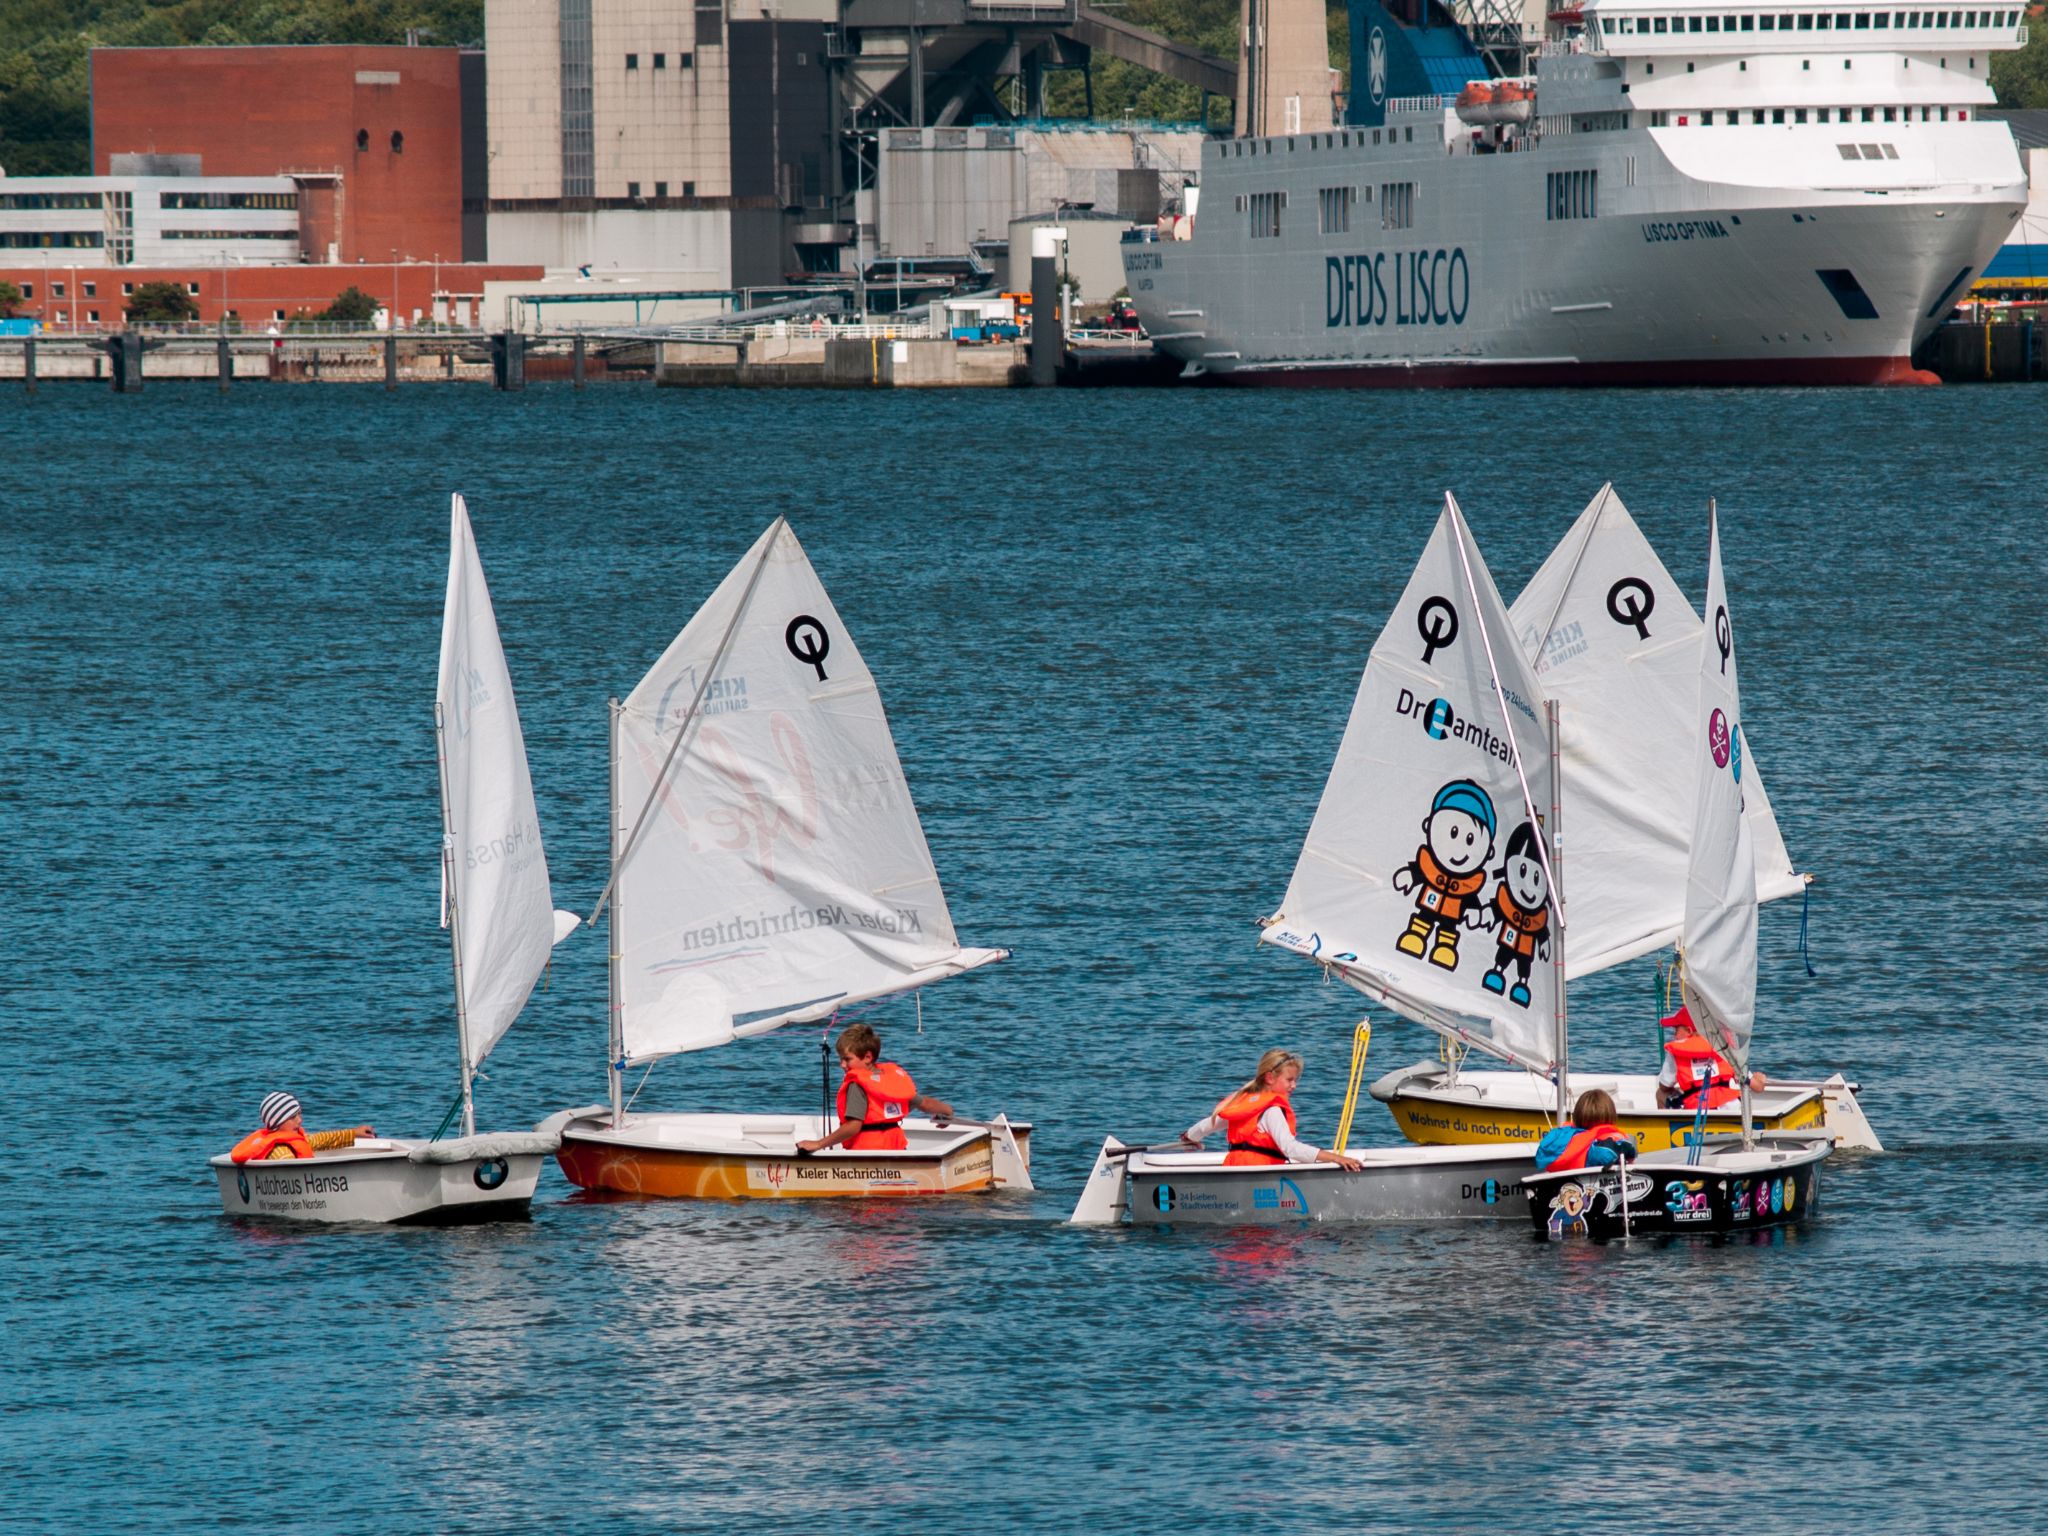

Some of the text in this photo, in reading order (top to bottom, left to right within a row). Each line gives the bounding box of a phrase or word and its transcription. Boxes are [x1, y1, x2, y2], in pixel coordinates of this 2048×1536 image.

[1641, 220, 1729, 242] LISCO OPTIMA
[1326, 247, 1470, 327] DFDS LISCO
[1407, 1111, 1450, 1129] Wohnst
[1453, 1119, 1469, 1132] du
[1471, 1122, 1500, 1136] noch
[1504, 1125, 1534, 1139] oder
[1537, 1126, 1548, 1139] le
[796, 1167, 828, 1179] Kieler
[831, 1167, 901, 1179] Nachrichten
[255, 1173, 349, 1195] Autohaus Hansa
[1461, 1178, 1525, 1204] Dream
[290, 1200, 302, 1210] den
[303, 1199, 327, 1209] Norden
[1180, 1201, 1239, 1210] Stadtwerke Kiel
[1280, 1200, 1296, 1208] CITY
[1676, 1210, 1710, 1220] wir drei
